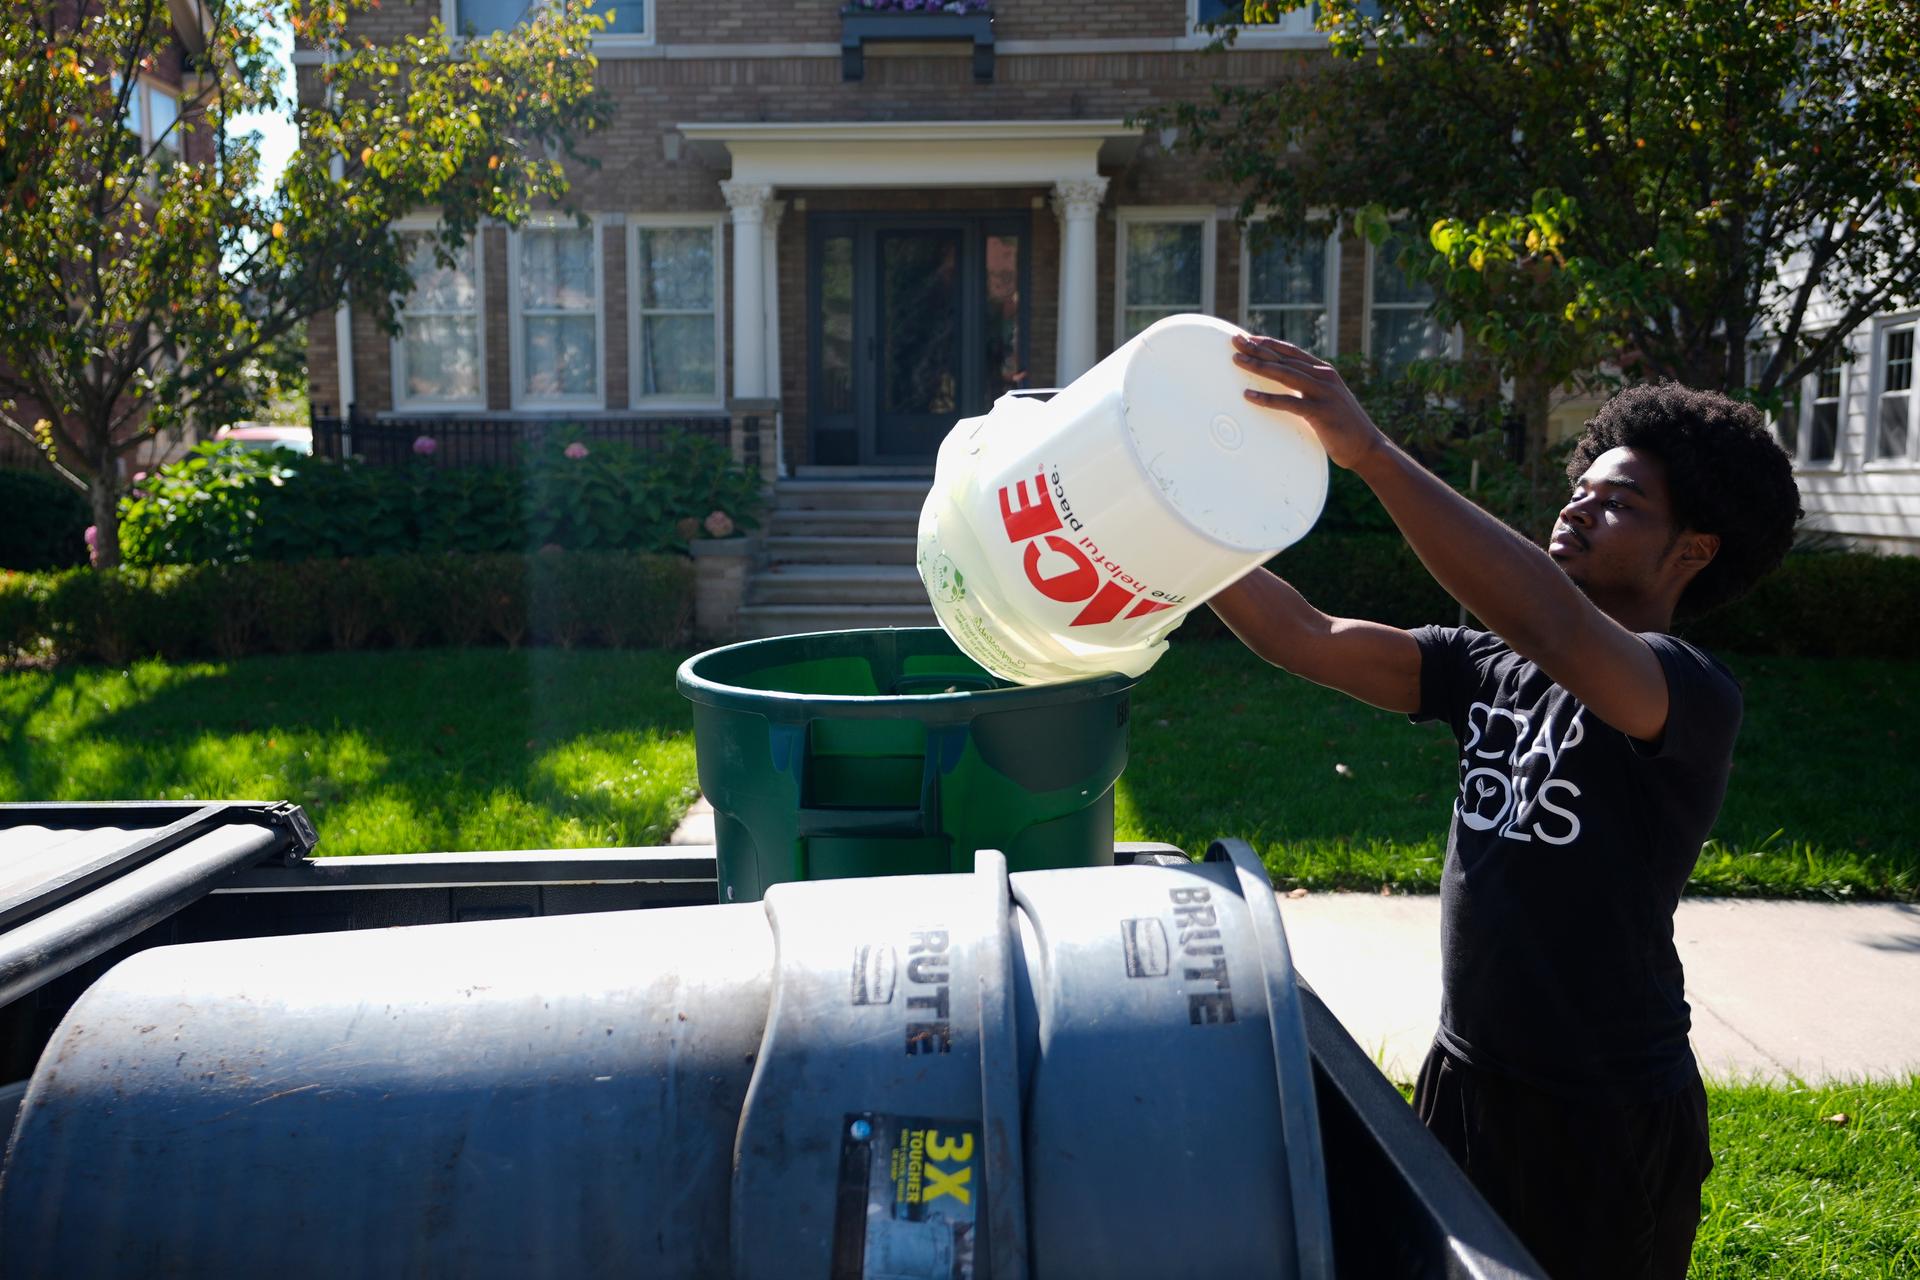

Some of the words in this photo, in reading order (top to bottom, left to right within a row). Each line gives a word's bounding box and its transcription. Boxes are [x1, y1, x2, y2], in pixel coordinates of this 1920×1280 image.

[1051, 464, 1083, 532] place.
[998, 473, 1177, 627] ACE
[1079, 536, 1147, 594] helpful
[1151, 590, 1187, 603] The
[905, 924, 950, 1056] RUTE
[1169, 887, 1235, 1025] BRUTE
[907, 1129, 925, 1203] TOUGHER
[922, 1129, 974, 1205] 3X
